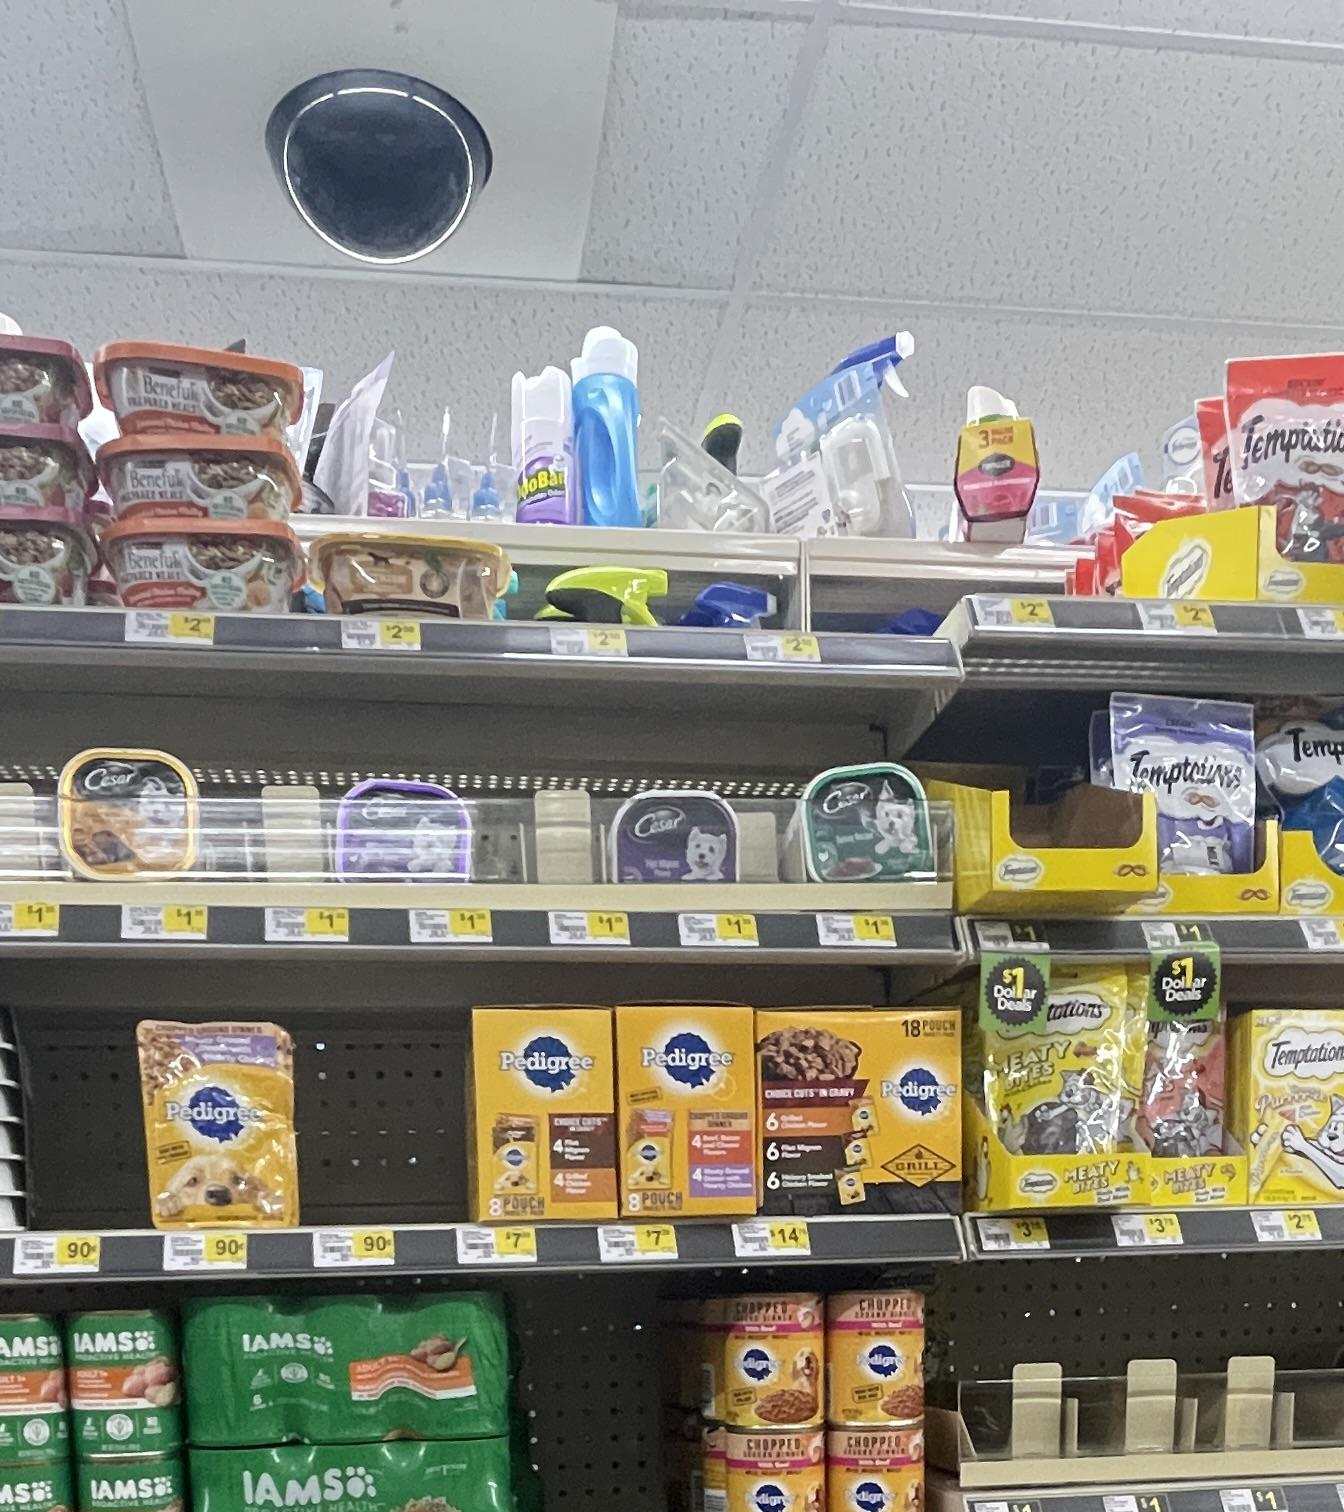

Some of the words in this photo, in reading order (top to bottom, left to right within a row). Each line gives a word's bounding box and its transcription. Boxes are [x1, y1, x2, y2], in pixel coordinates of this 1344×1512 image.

[979, 429, 990, 448] 3
[85, 768, 134, 790] Cesar
[1172, 957, 1193, 988] $1
[1002, 966, 1025, 999] $1
[1166, 988, 1201, 1001] Deals
[998, 997, 1031, 1011] Deals
[901, 1020, 921, 1037] 18
[499, 1052, 593, 1073] Pedigree
[642, 1049, 733, 1070] Pedigree
[881, 1081, 956, 1099] Pedigree
[166, 1102, 261, 1123] Pedigree
[767, 1113, 778, 1130] 6
[553, 1139, 563, 1153] 4
[767, 1142, 780, 1160] 6
[896, 1163, 941, 1171] GRILL
[1064, 1162, 1118, 1182] MEATY
[767, 1172, 780, 1189] 6
[490, 1198, 501, 1215] 8
[628, 1194, 640, 1211] 8
[642, 1193, 682, 1205] POUCH
[74, 1332, 134, 1353] IAMS
[242, 1333, 312, 1350] IAMS
[91, 1479, 152, 1500] IAMS
[242, 1467, 346, 1508] IAMS
[328, 1501, 378, 1512] HEALTH
